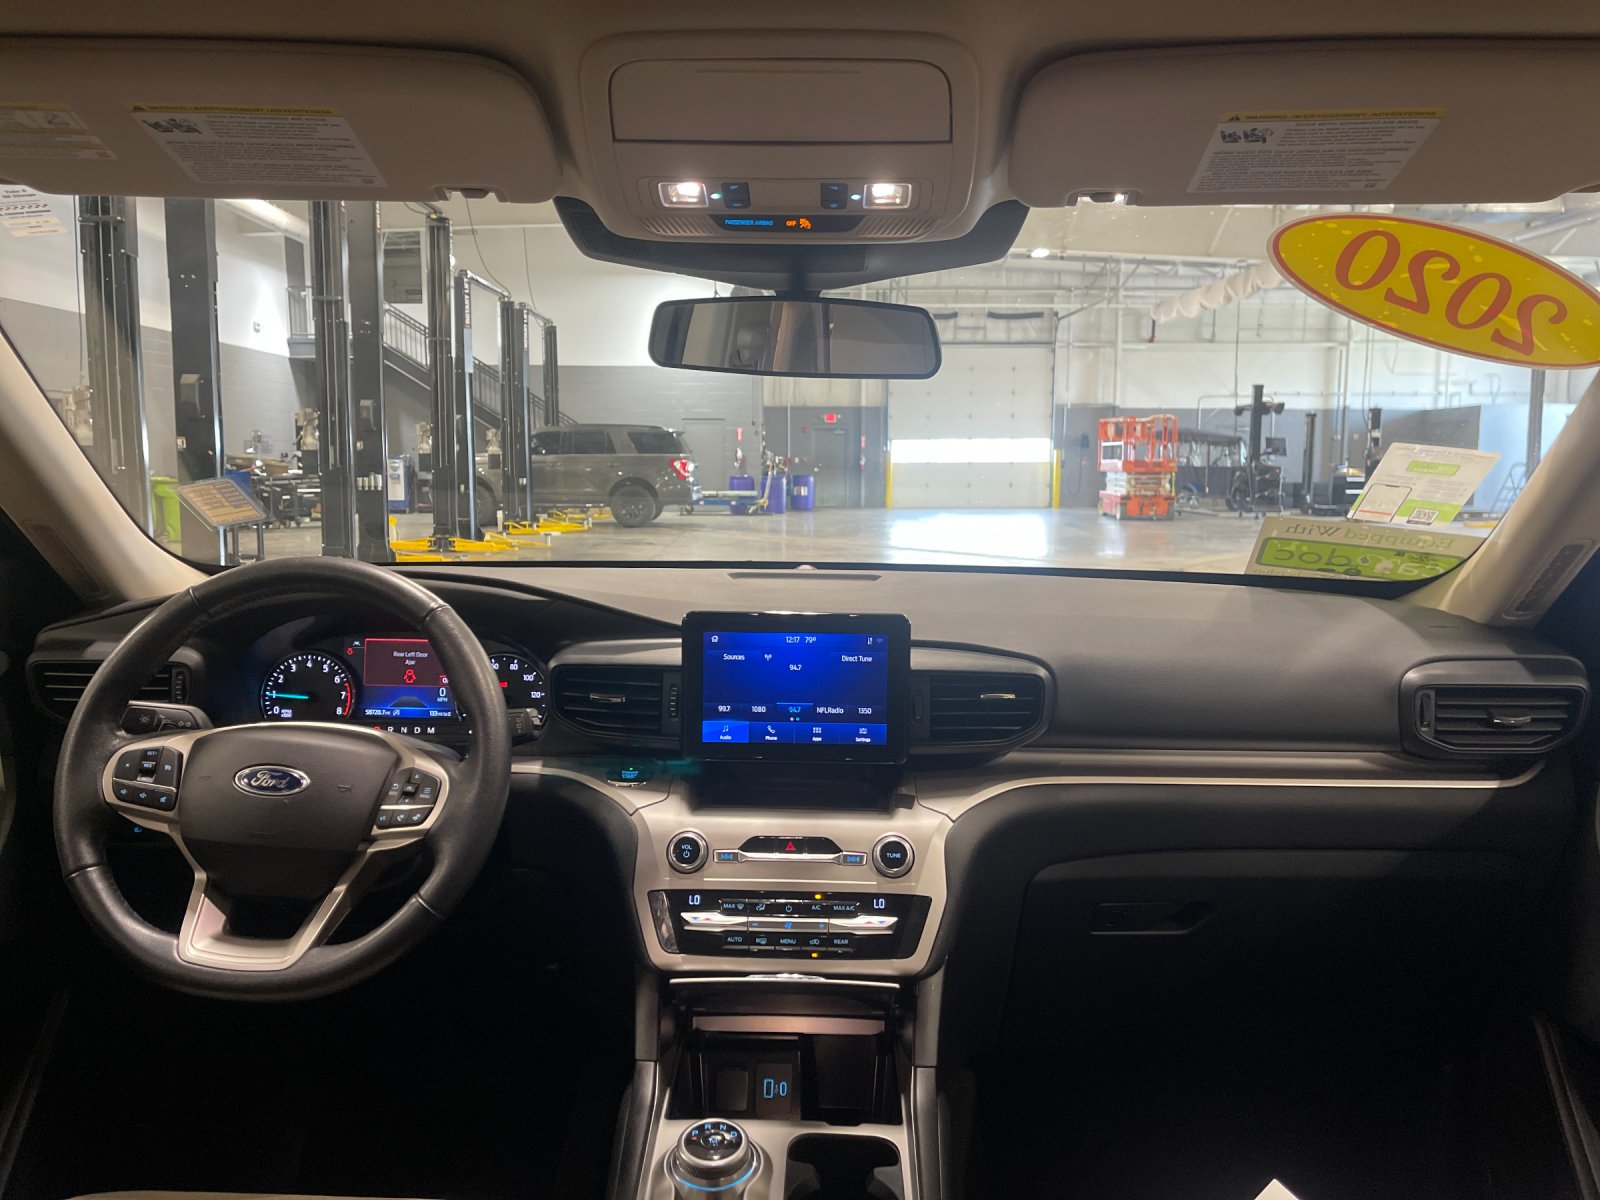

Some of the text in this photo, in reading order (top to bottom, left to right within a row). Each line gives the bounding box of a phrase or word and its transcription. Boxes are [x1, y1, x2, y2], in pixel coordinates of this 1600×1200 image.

[785, 635, 801, 644] 12:17
[723, 653, 746, 661] Sources
[841, 654, 873, 663] Direct Tune
[290, 664, 297, 672] 3
[306, 659, 313, 668] 4
[322, 664, 329, 673] 5
[278, 674, 284, 683] 2
[334, 675, 341, 684] 6
[522, 674, 535, 682] 100
[340, 691, 346, 700] 7
[530, 691, 541, 699] 120
[273, 705, 279, 714] 0
[336, 707, 342, 715] 8
[858, 707, 872, 715] 1350
[401, 726, 408, 734] N
[414, 726, 421, 734] D
[427, 726, 435, 734] M
[250, 770, 288, 788] Ford
[688, 894, 701, 905] LO
[873, 898, 885, 909] LO
